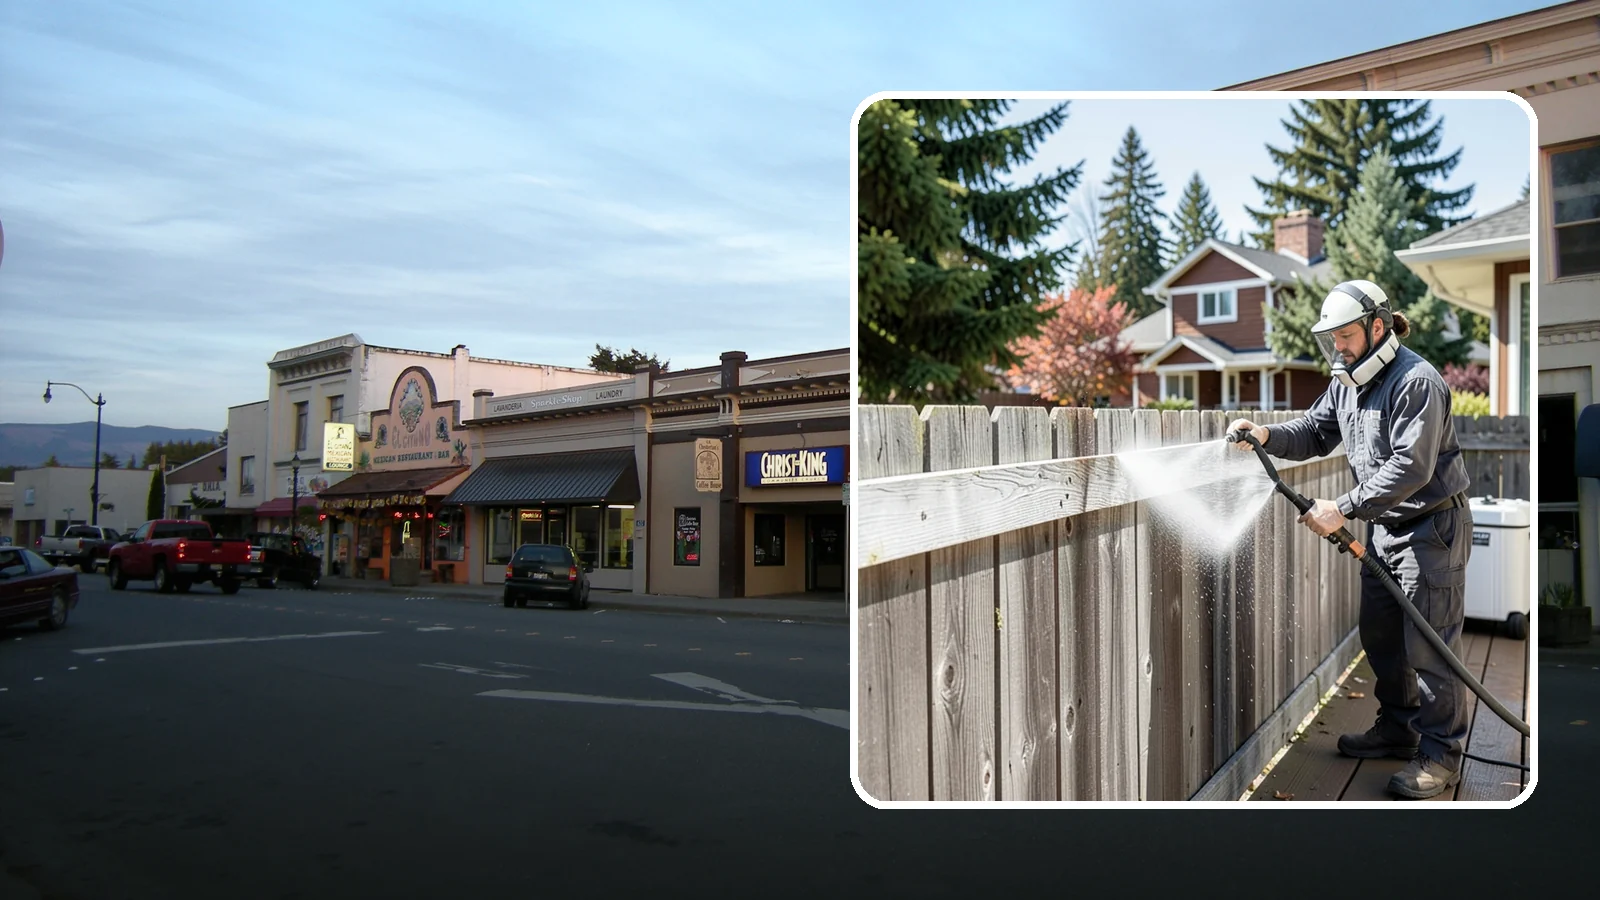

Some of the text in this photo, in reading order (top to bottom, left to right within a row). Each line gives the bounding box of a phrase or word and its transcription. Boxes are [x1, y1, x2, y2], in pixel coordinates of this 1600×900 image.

[595, 389, 623, 400] LAUNDRY
[493, 402, 522, 412] LAVANDERIA
[392, 425, 402, 449] EL
[374, 450, 450, 464] MEXICAN RESTAURANT BAR
[761, 450, 827, 478] CHRIST KING
